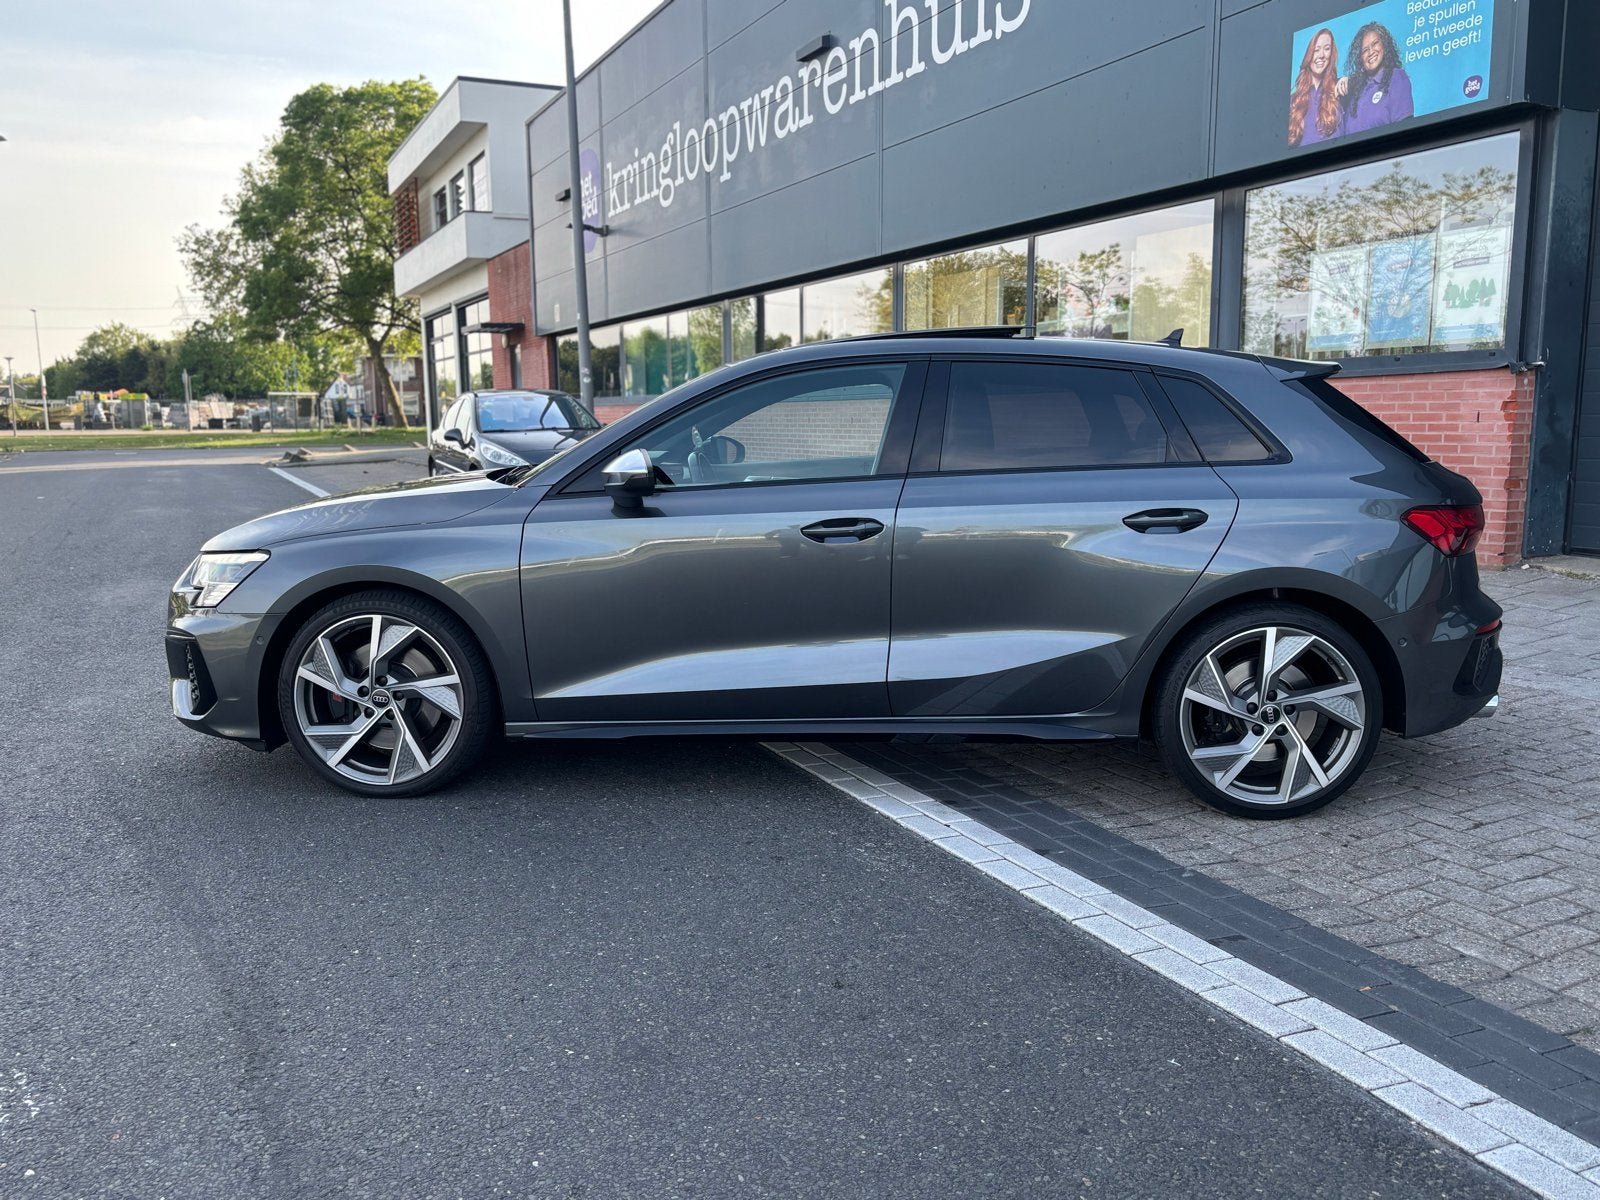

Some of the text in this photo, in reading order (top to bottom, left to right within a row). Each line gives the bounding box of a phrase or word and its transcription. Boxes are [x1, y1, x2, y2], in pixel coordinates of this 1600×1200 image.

[1406, 14, 1483, 47] een tweede
[1413, 0, 1476, 33] je spullen
[1405, 29, 1481, 63] leven geeft!
